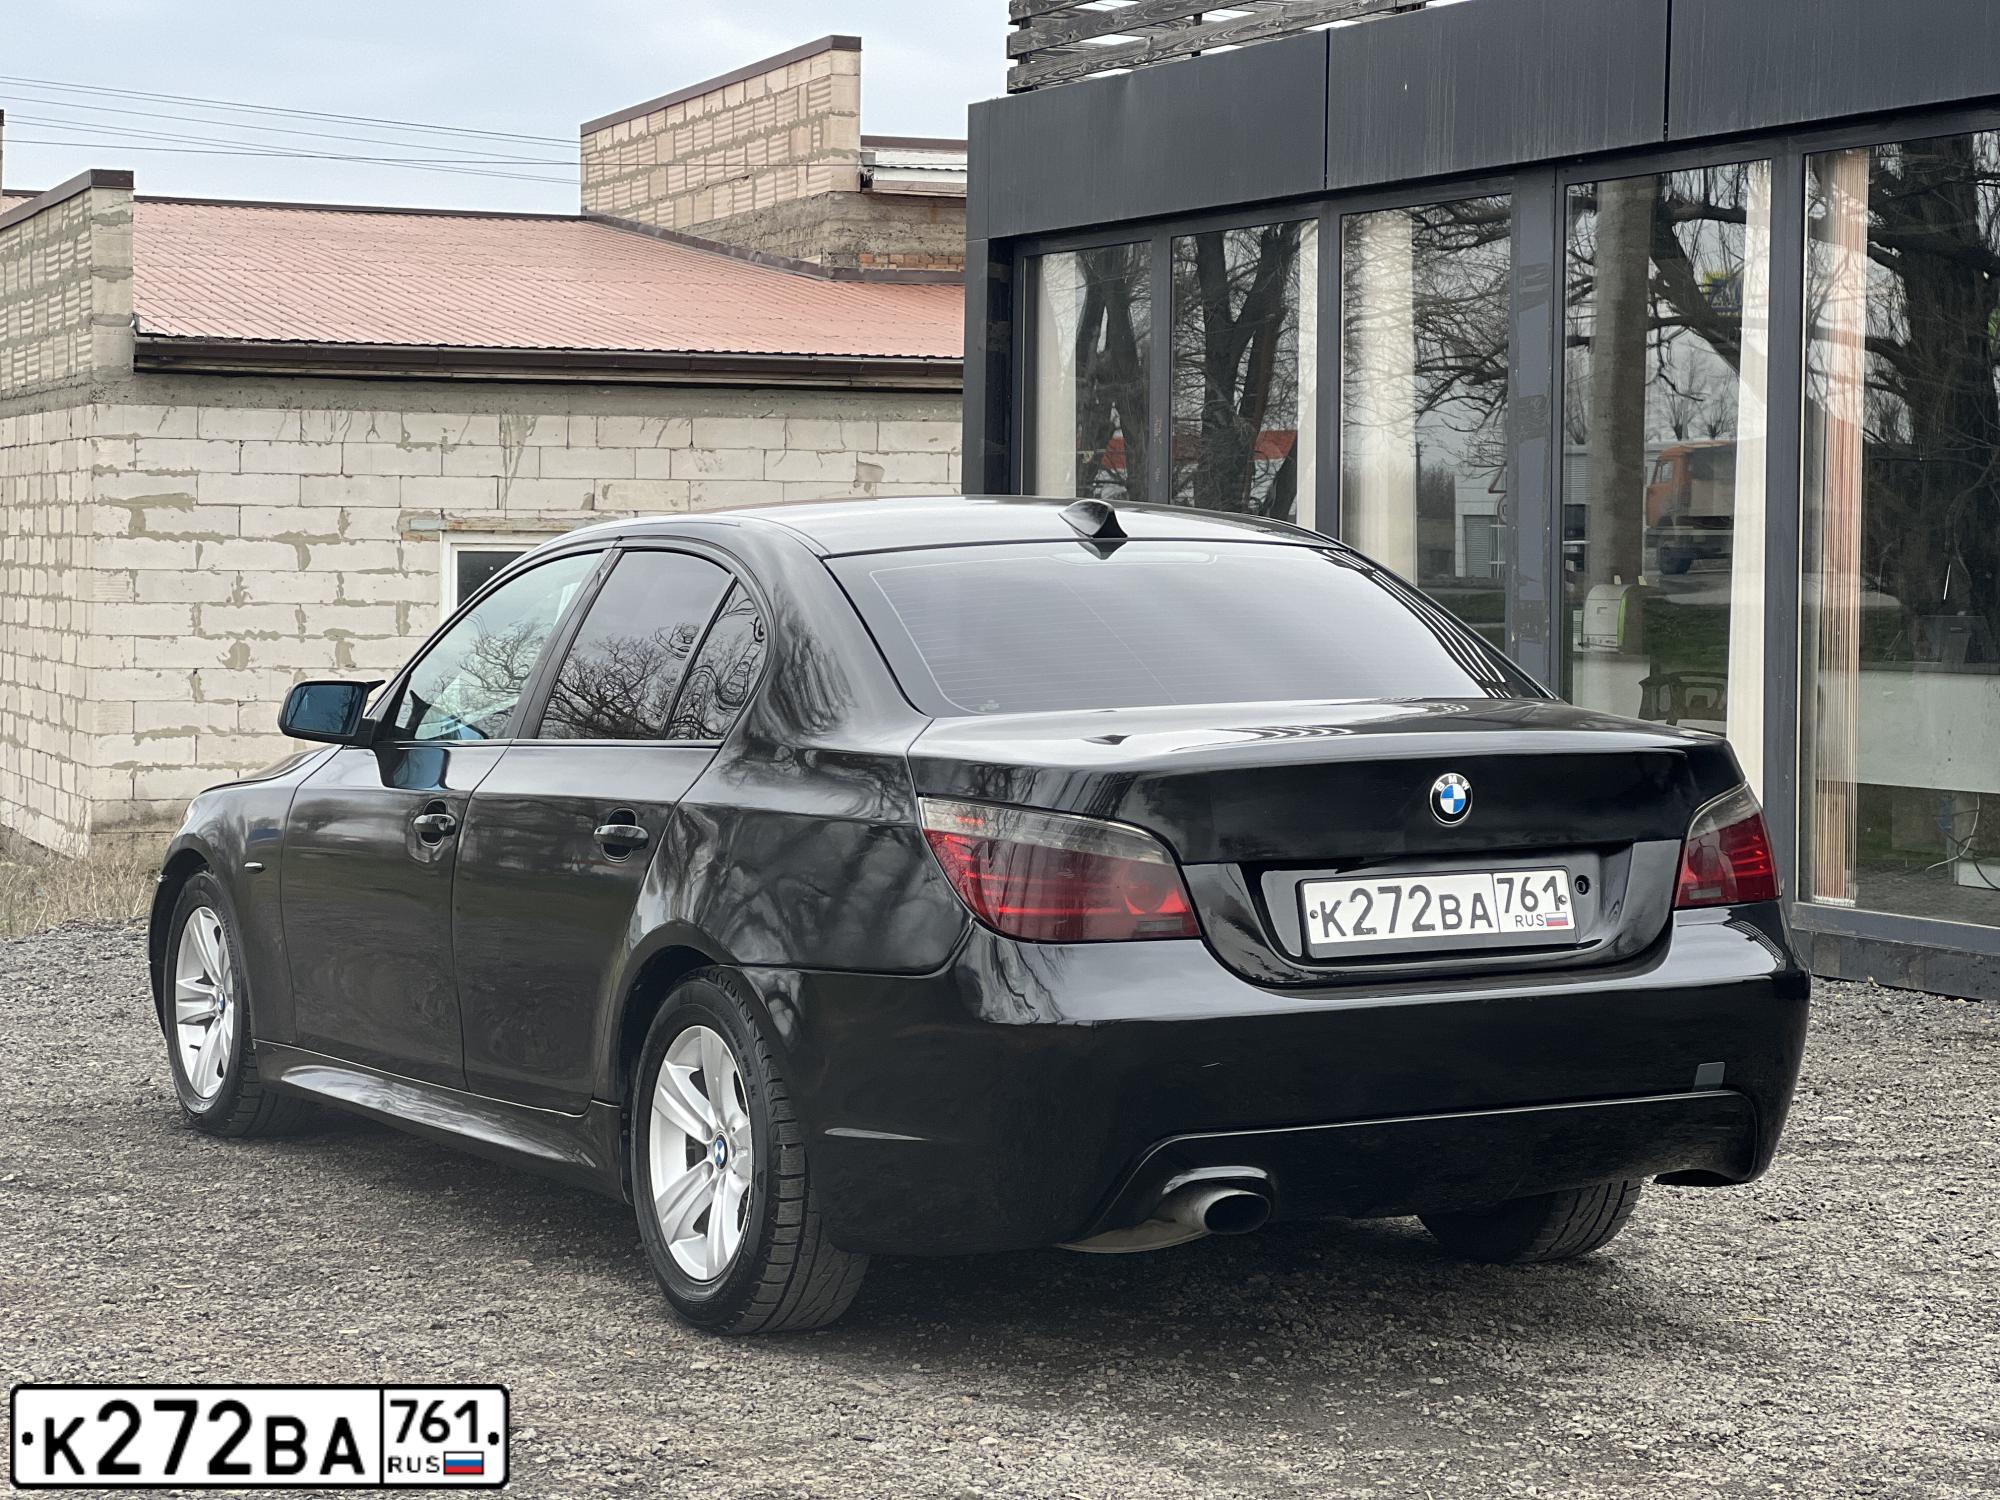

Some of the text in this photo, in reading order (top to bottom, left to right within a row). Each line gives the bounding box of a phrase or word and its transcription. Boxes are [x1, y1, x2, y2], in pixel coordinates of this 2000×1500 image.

[1435, 775, 1470, 791] BMW
[1497, 876, 1560, 913] 761
[1515, 914, 1544, 927] RUS
